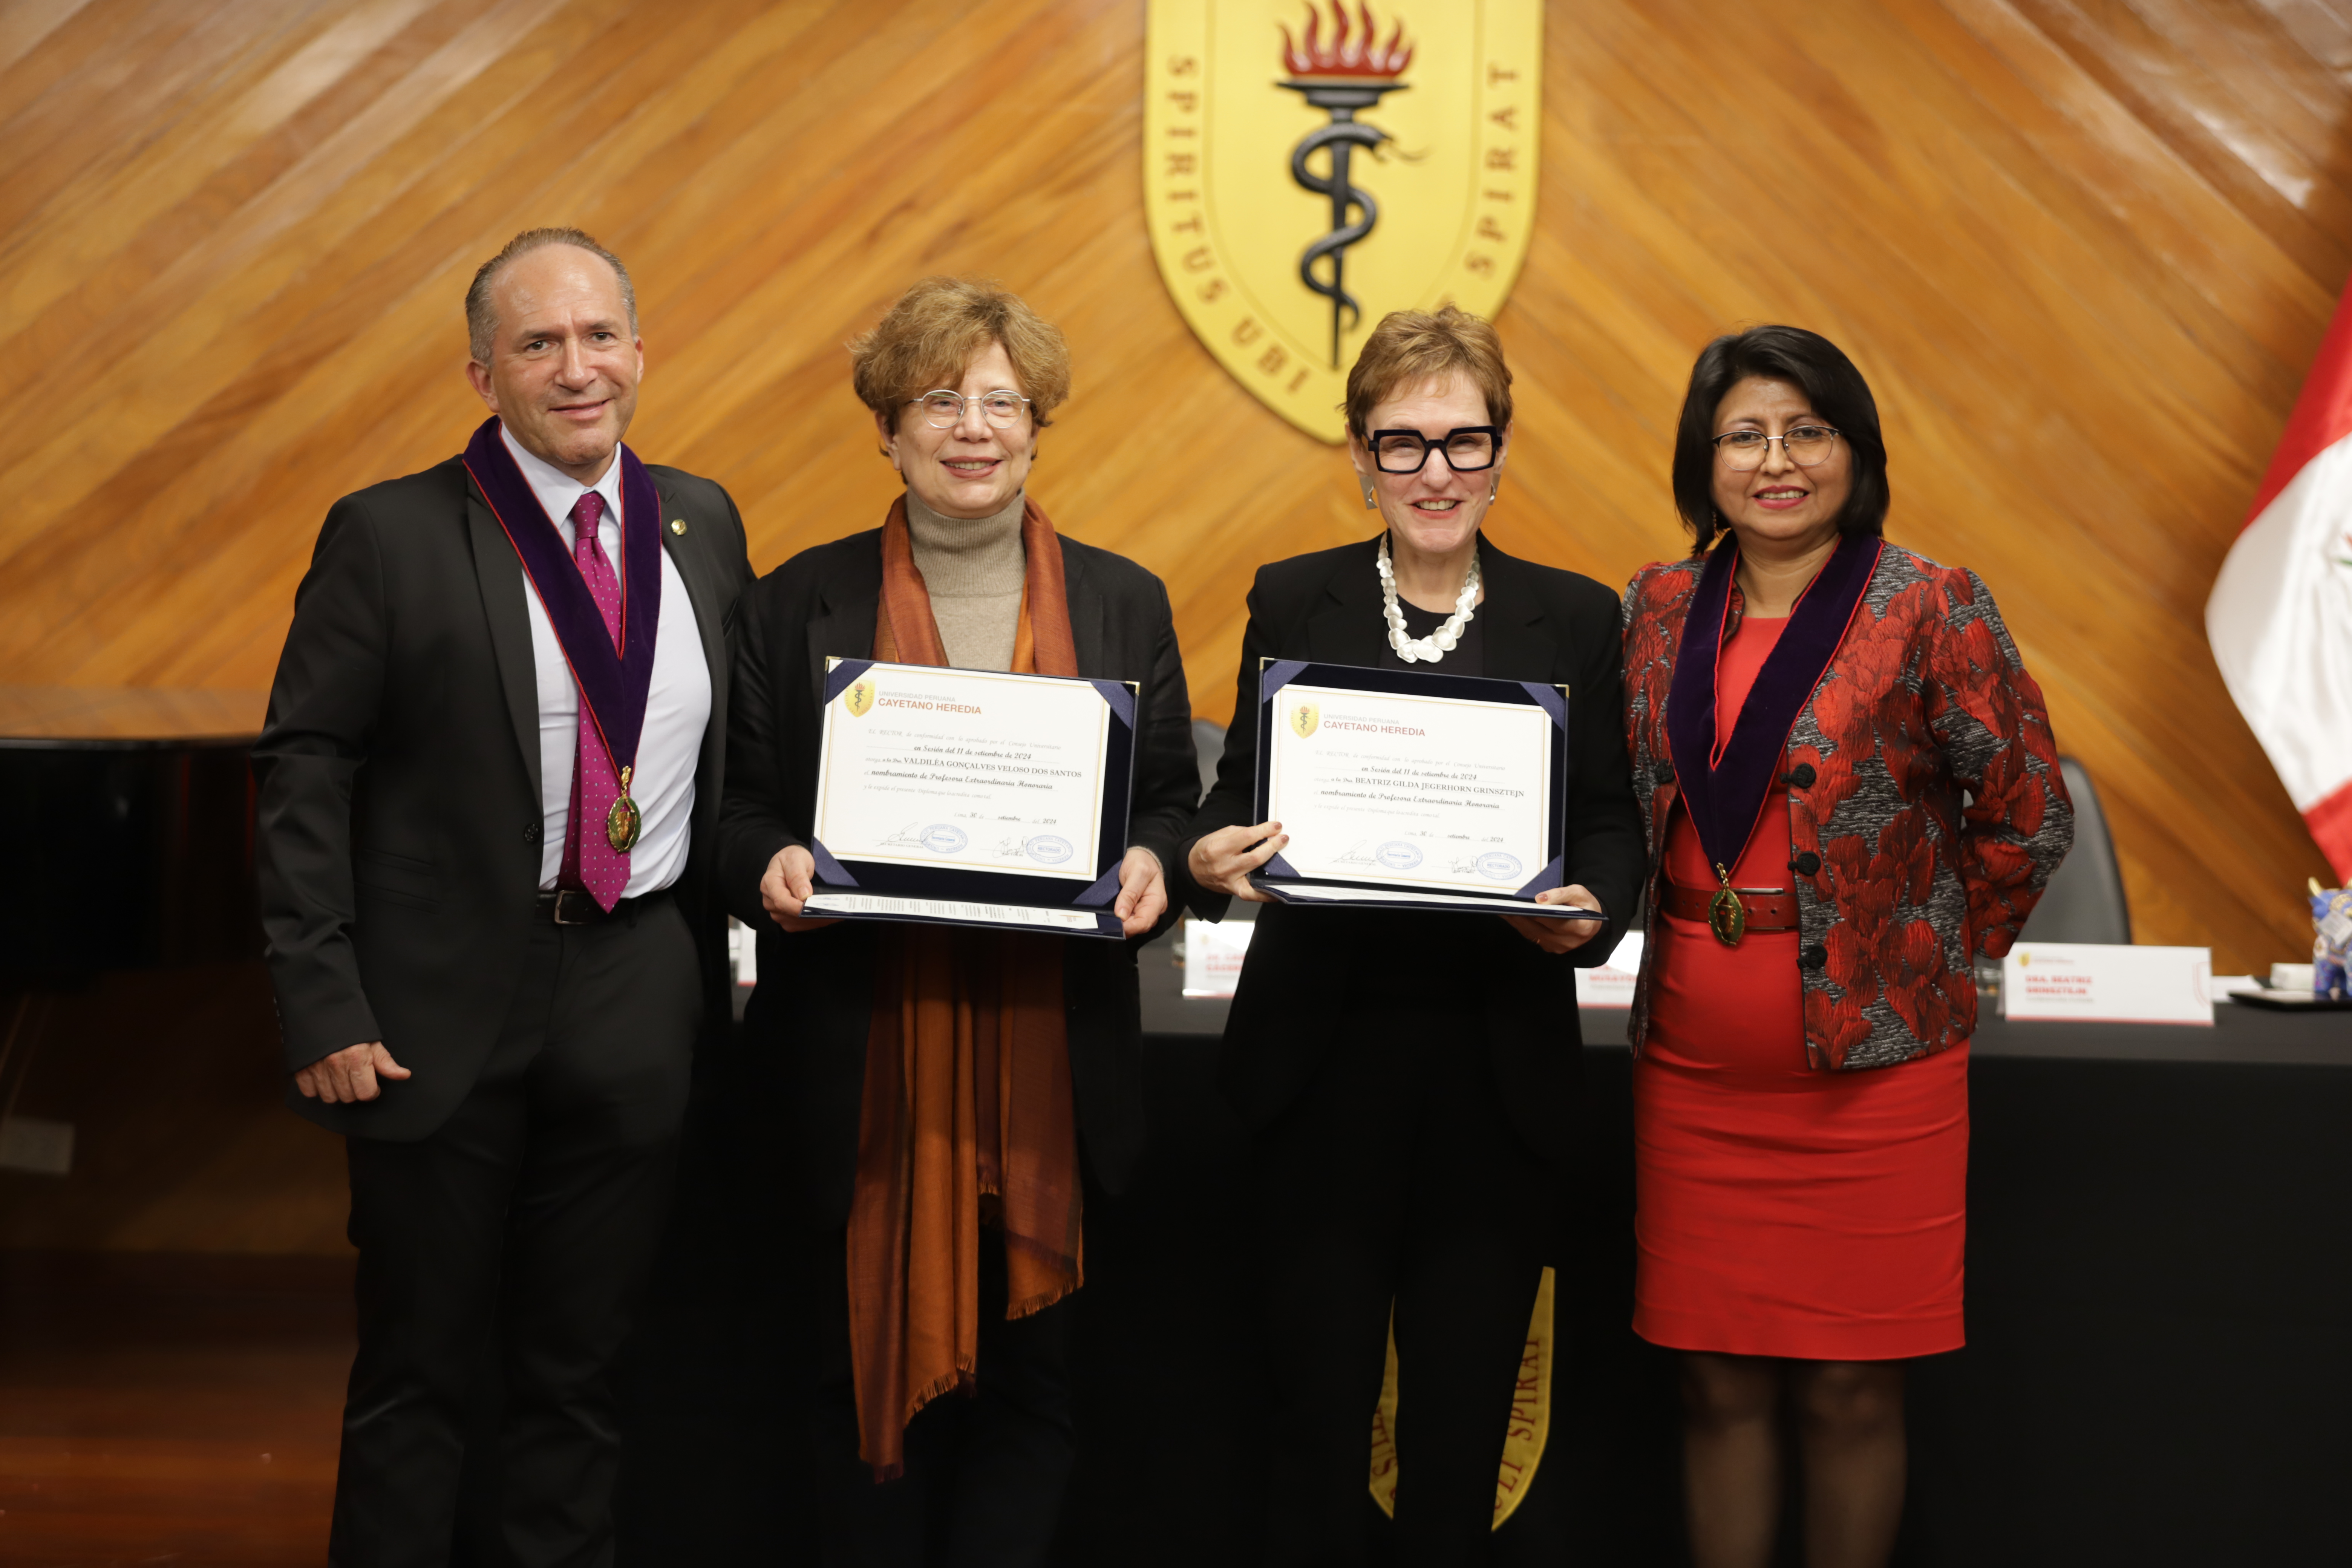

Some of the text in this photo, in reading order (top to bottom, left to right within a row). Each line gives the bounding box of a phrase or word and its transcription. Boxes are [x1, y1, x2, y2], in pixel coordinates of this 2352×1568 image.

[1464, 60, 1521, 282] SPIRAT
[1165, 53, 1314, 395] SPIRITUS UBI
[879, 691, 923, 699] UNIVERSIDAD
[878, 698, 933, 710] CAYETANO
[936, 703, 982, 714] HEREDIA
[1324, 721, 1378, 732] CAYETANO
[1381, 726, 1425, 736] HEREDIA
[904, 757, 945, 766] VALDILÉA
[946, 760, 995, 770] GONÇALVES
[998, 765, 1029, 773] VELOSO
[1050, 769, 1082, 778] SANTOS
[871, 769, 918, 779] nombramiento
[929, 773, 963, 782] Profesora
[965, 776, 1015, 786] Extraordinaria
[1017, 780, 1053, 790] Honoraria
[1355, 777, 1391, 786] BEATRIZ
[1421, 782, 1471, 792] JEGERHORN
[1473, 787, 1524, 798] GRINSZTEJN
[1321, 789, 1366, 798] nombramiento
[1378, 793, 1411, 802] Profesora
[1413, 796, 1462, 806] Extraordinaria
[1464, 799, 1499, 809] Honoraria
